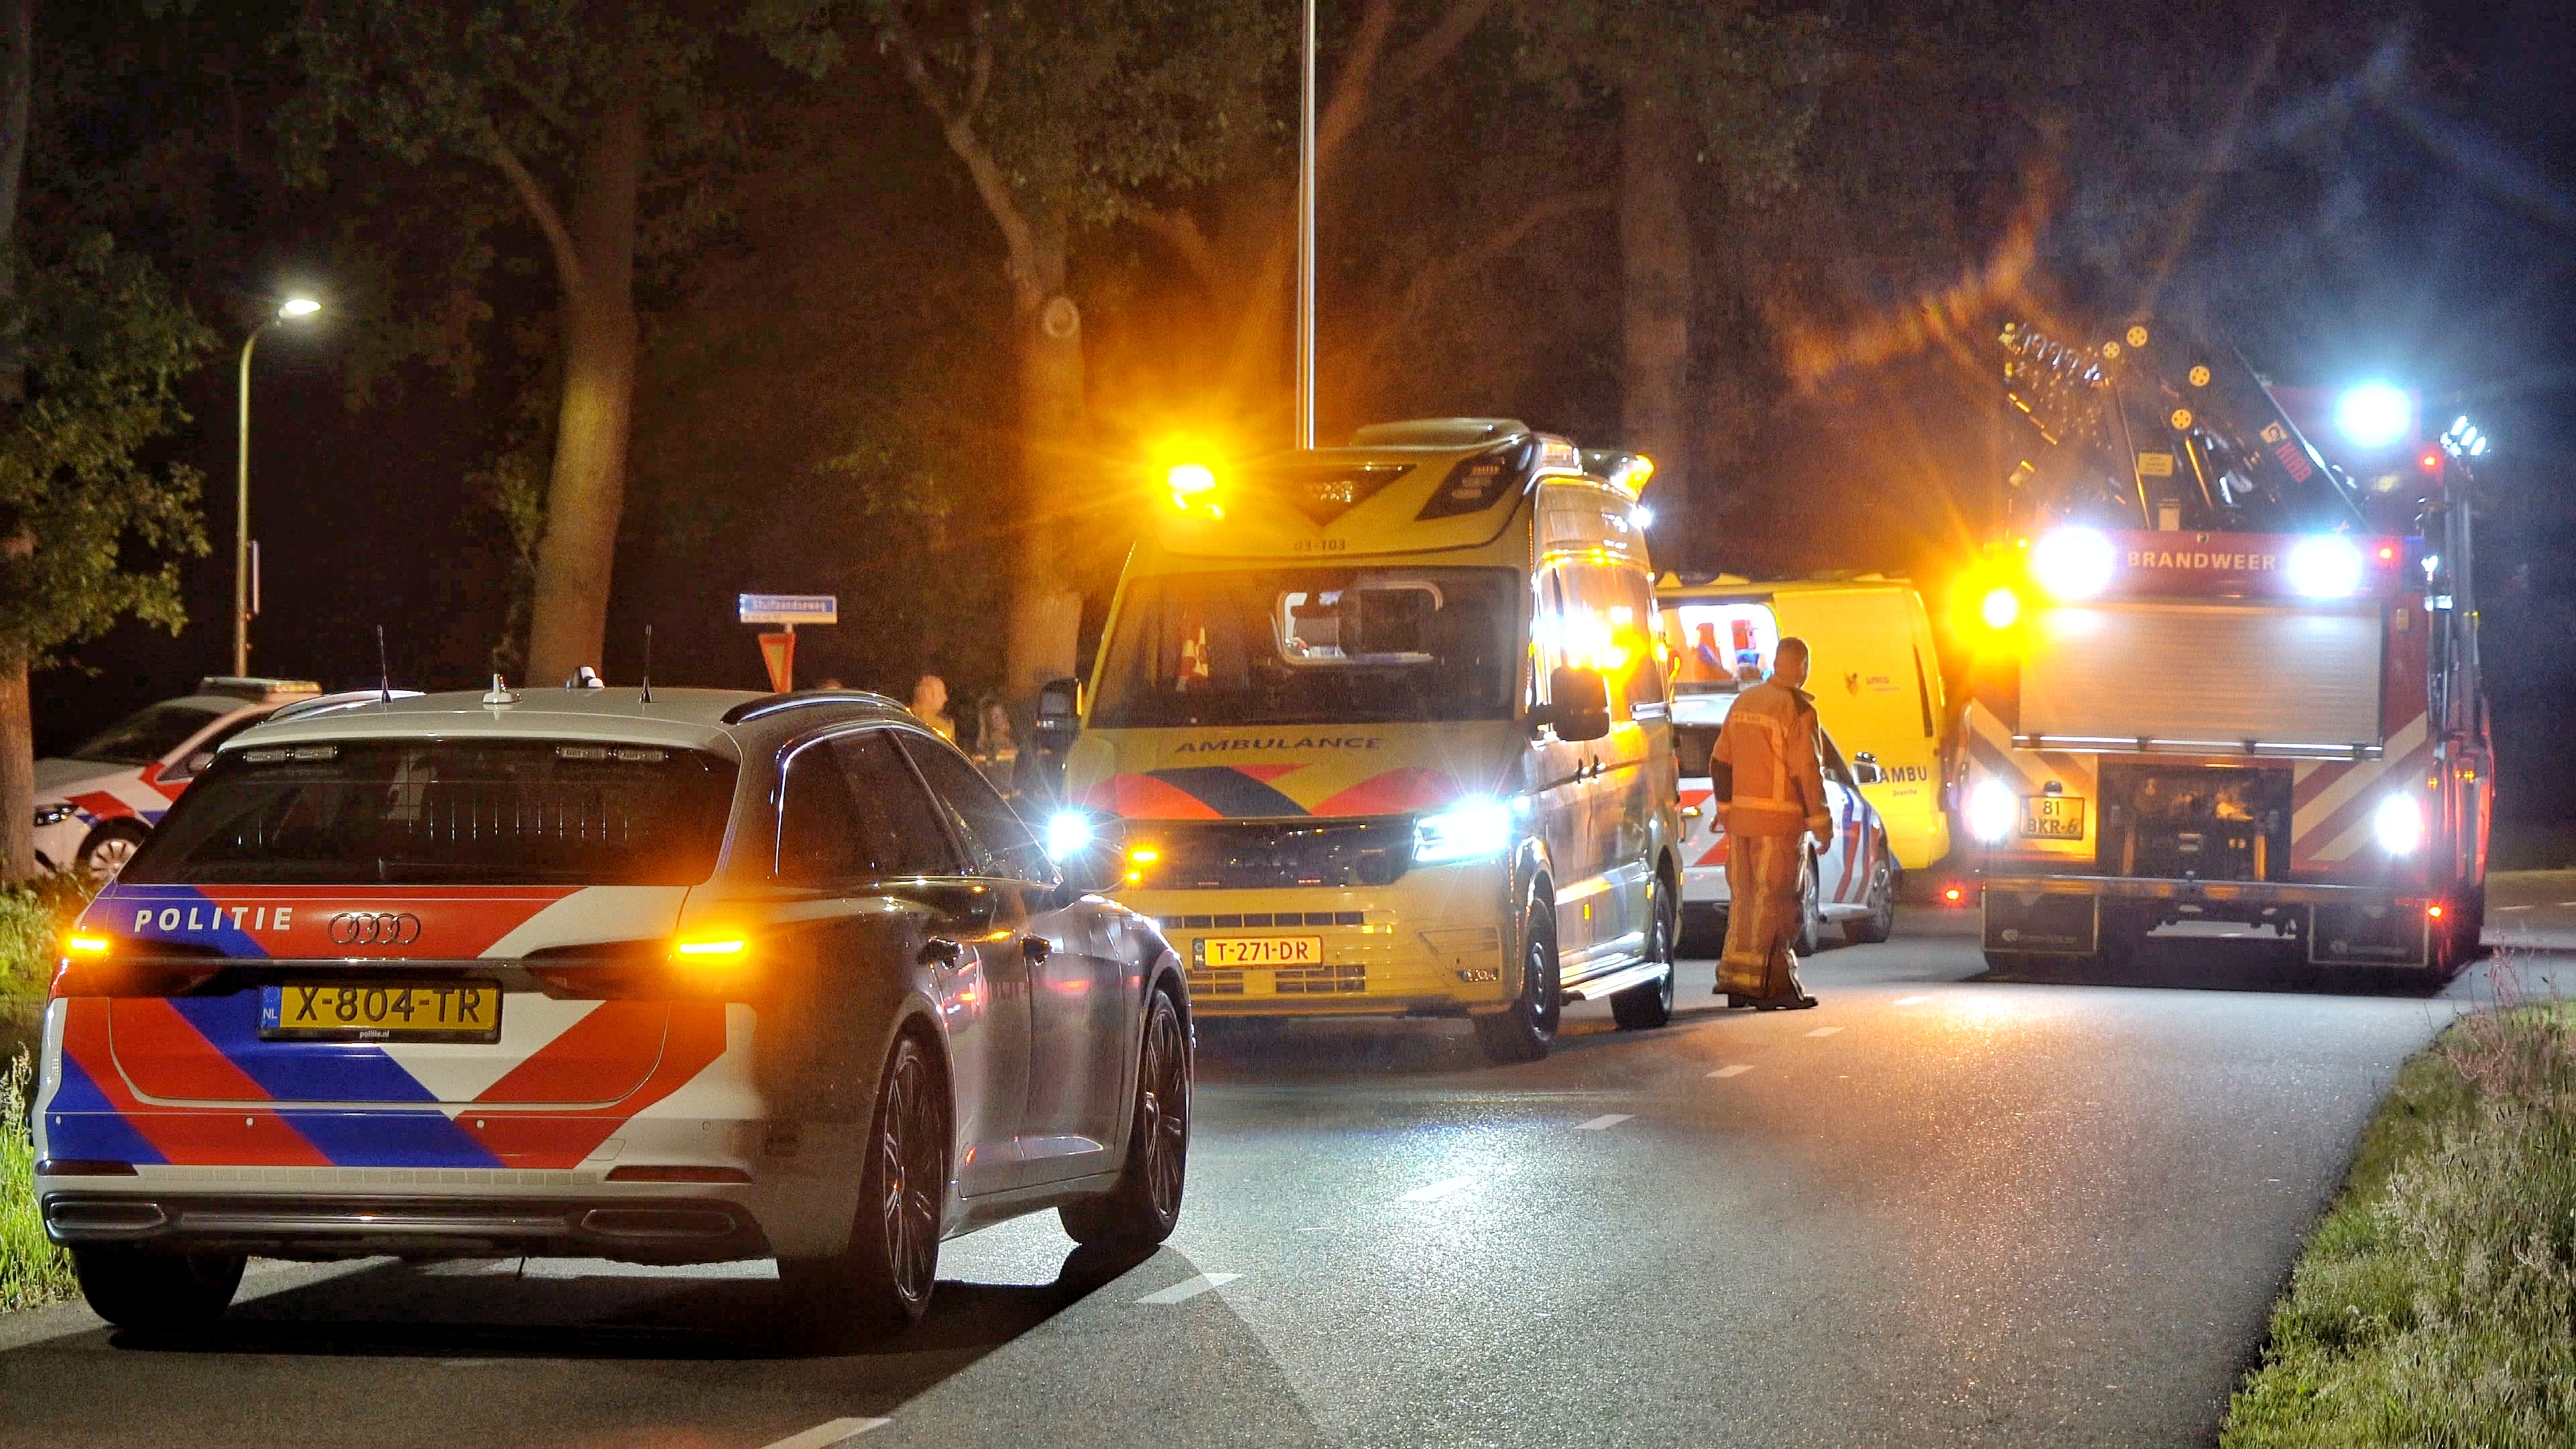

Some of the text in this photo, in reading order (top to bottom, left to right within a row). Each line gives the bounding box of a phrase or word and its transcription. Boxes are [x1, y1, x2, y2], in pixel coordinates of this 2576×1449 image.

[2127, 551, 2277, 571] BRANDWEER
[1174, 737, 1383, 753] AMBULANCE
[1880, 765, 1927, 784] AMBU
[2043, 800, 2060, 816] 81
[133, 906, 293, 932] POLITIE
[1216, 941, 1309, 961] T-271-DR
[263, 1008, 278, 1020] NL
[295, 986, 480, 1023] X-804-TR
